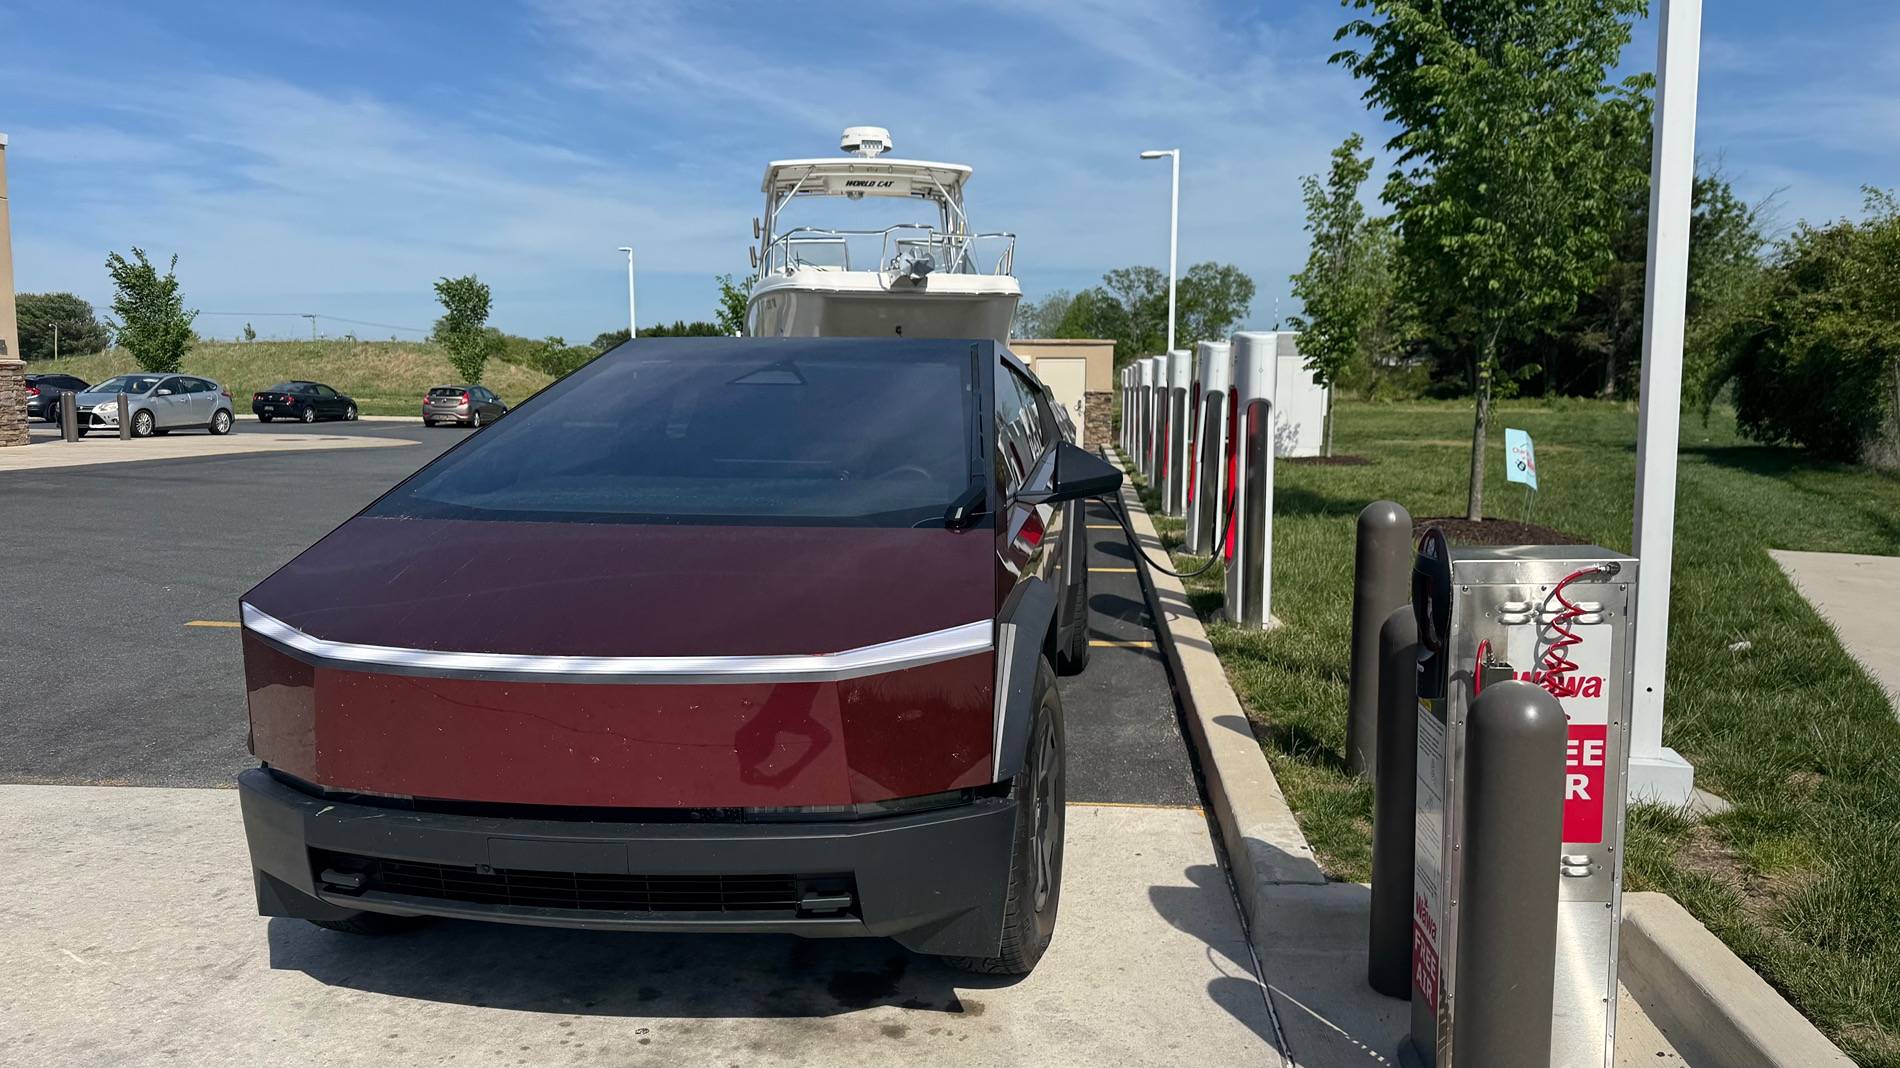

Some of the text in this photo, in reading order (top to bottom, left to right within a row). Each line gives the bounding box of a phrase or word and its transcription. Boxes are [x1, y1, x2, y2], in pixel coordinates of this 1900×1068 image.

[877, 180, 895, 188] CAT
[1566, 739, 1604, 767] EE
[1415, 895, 1437, 942] Wawa
[1415, 929, 1437, 981] FREE
[1416, 962, 1433, 1006] AIR
